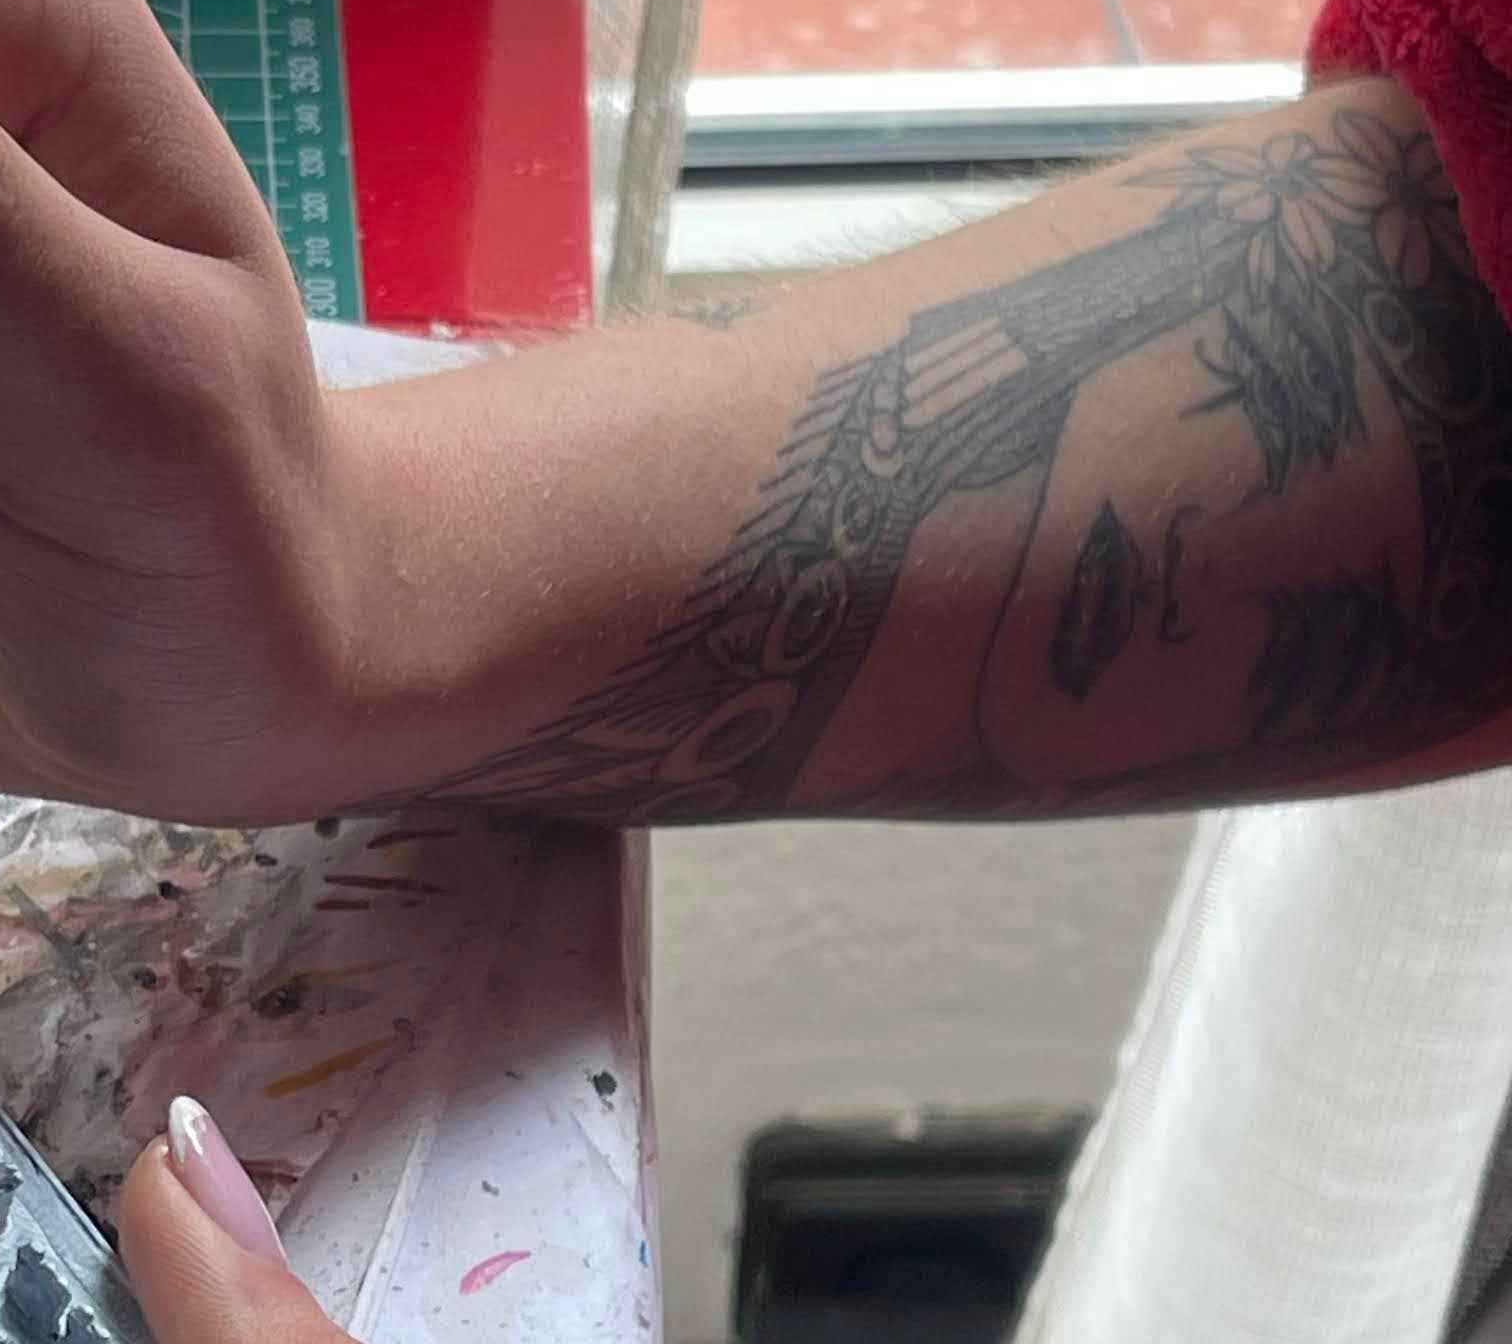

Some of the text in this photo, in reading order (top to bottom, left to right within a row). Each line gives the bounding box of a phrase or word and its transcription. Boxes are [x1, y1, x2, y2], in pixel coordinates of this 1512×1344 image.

[288, 55, 322, 94] 350
[294, 103, 323, 135] 340
[299, 146, 327, 179] 330
[301, 190, 329, 224] 320
[304, 236, 334, 269] 310
[303, 277, 339, 318] 300
